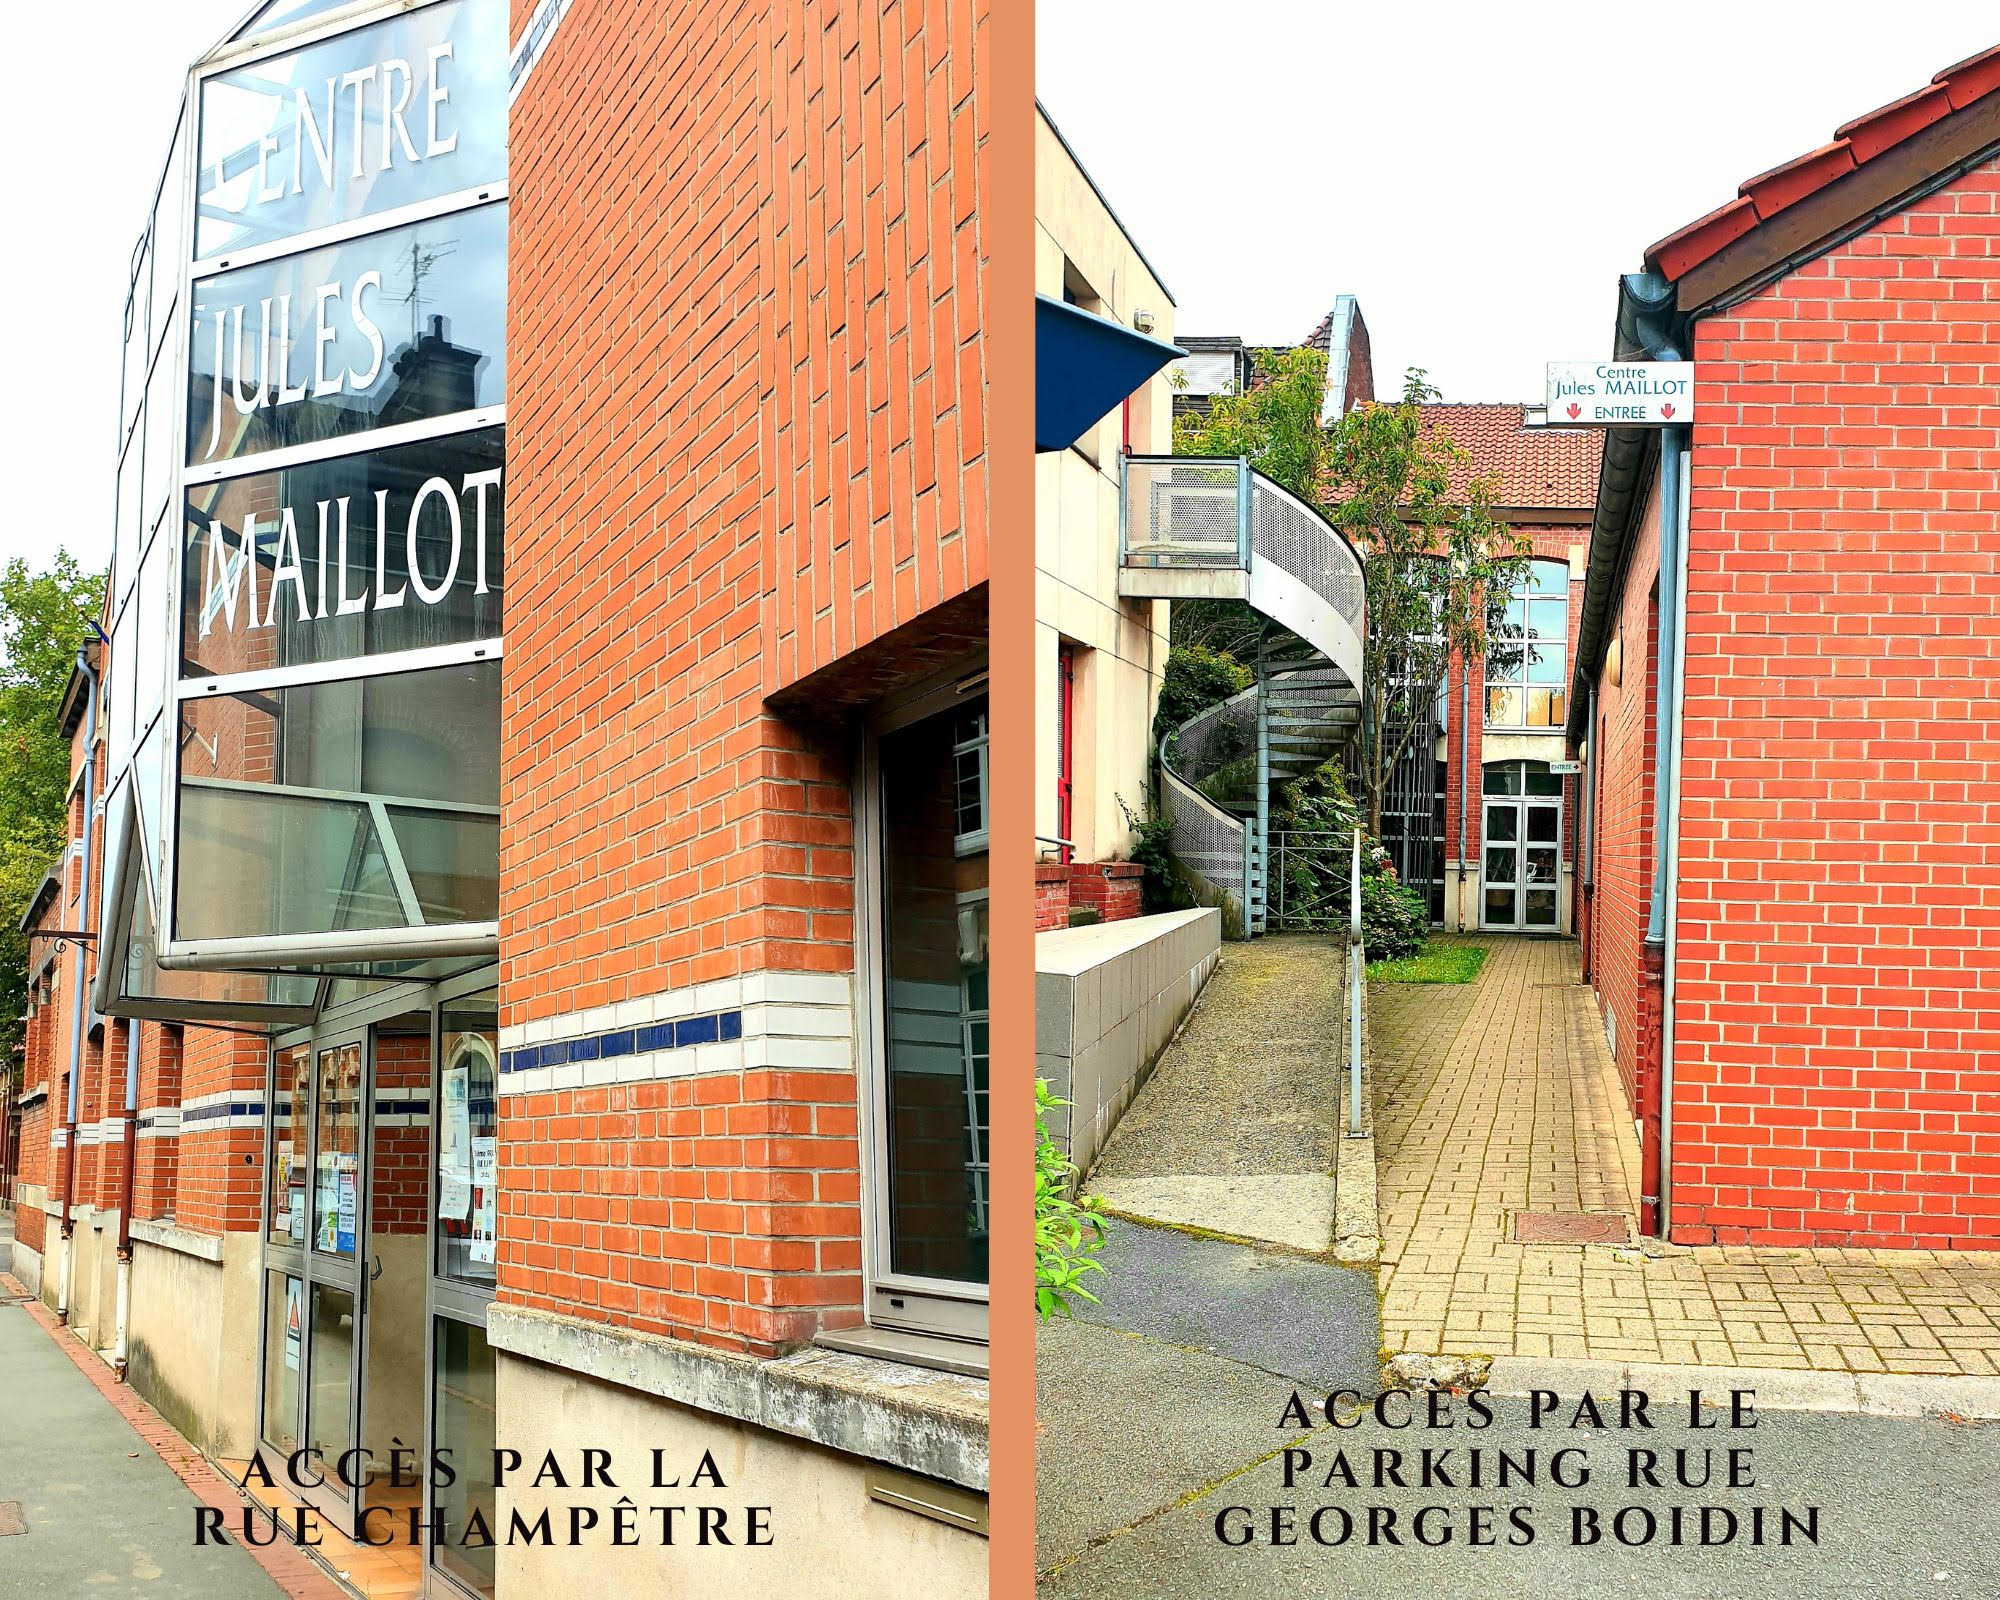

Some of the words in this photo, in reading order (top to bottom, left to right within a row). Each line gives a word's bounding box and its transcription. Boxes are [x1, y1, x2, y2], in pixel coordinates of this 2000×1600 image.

[204, 270, 383, 460] JULES
[1555, 380, 1596, 399] Jules
[1605, 380, 1688, 395] MAILLOT
[1596, 365, 1646, 379] Centre
[199, 466, 502, 642] MAILLOT
